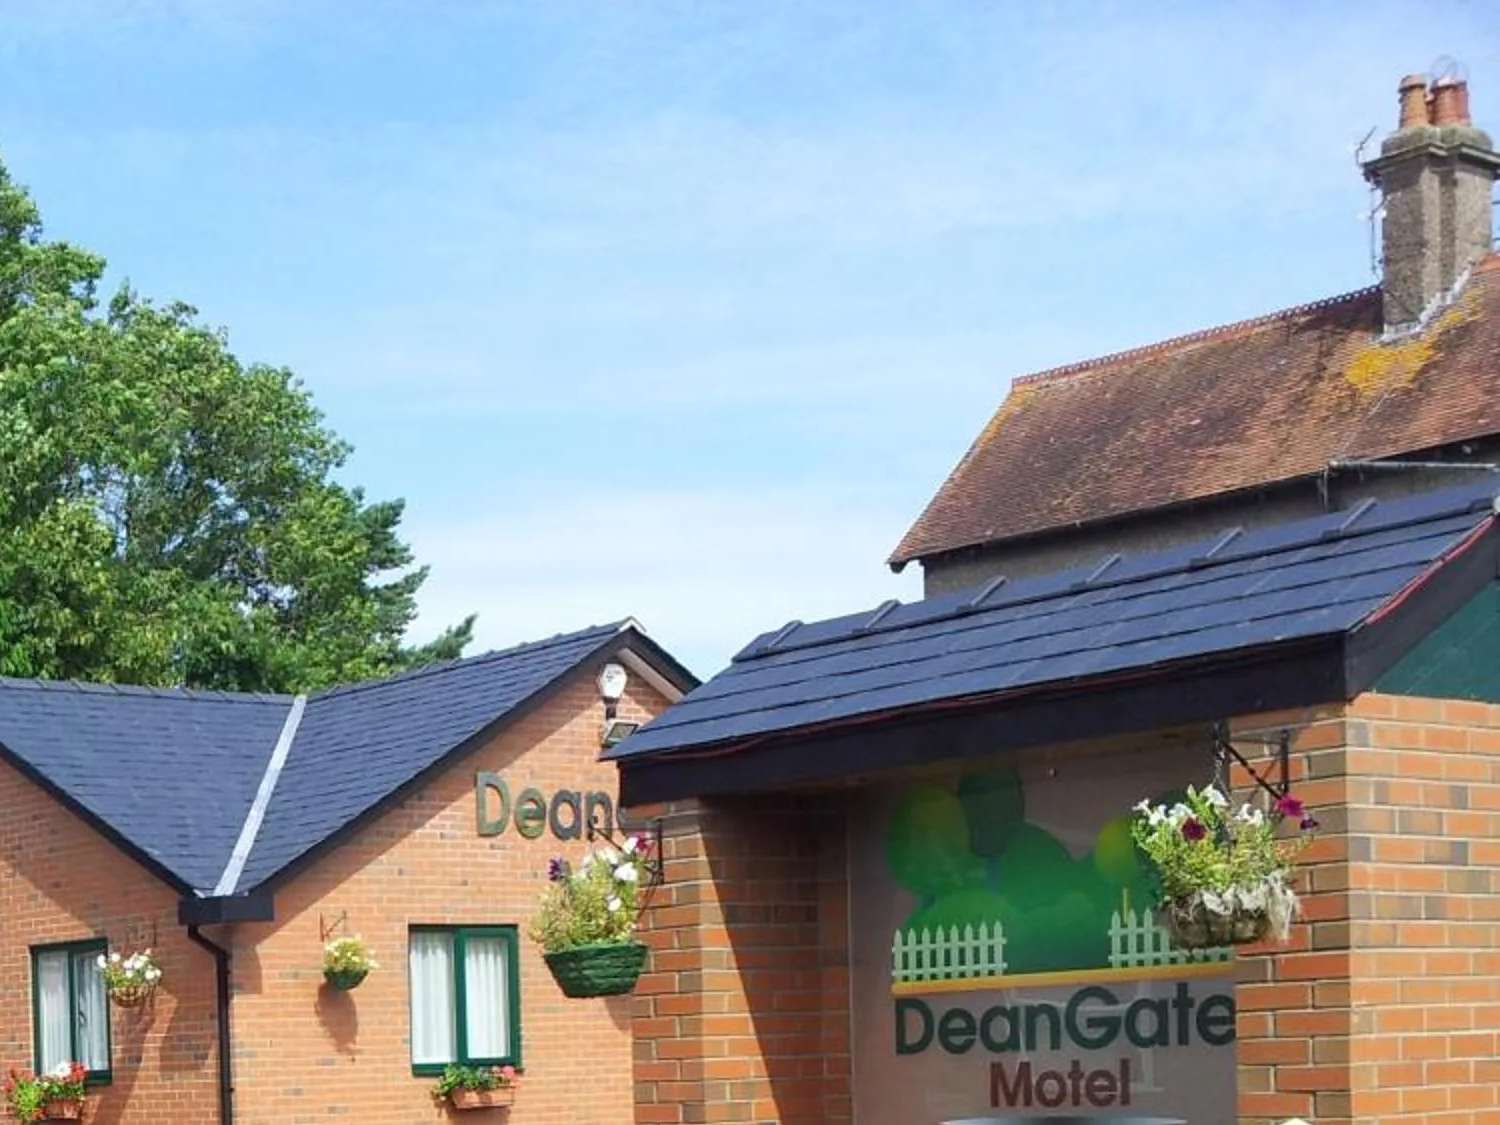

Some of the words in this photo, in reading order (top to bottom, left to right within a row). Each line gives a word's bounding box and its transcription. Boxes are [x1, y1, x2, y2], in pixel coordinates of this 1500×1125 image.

[475, 770, 627, 842] Dean
[895, 982, 1236, 1055] DeanGate
[990, 1058, 1131, 1108] Motel
